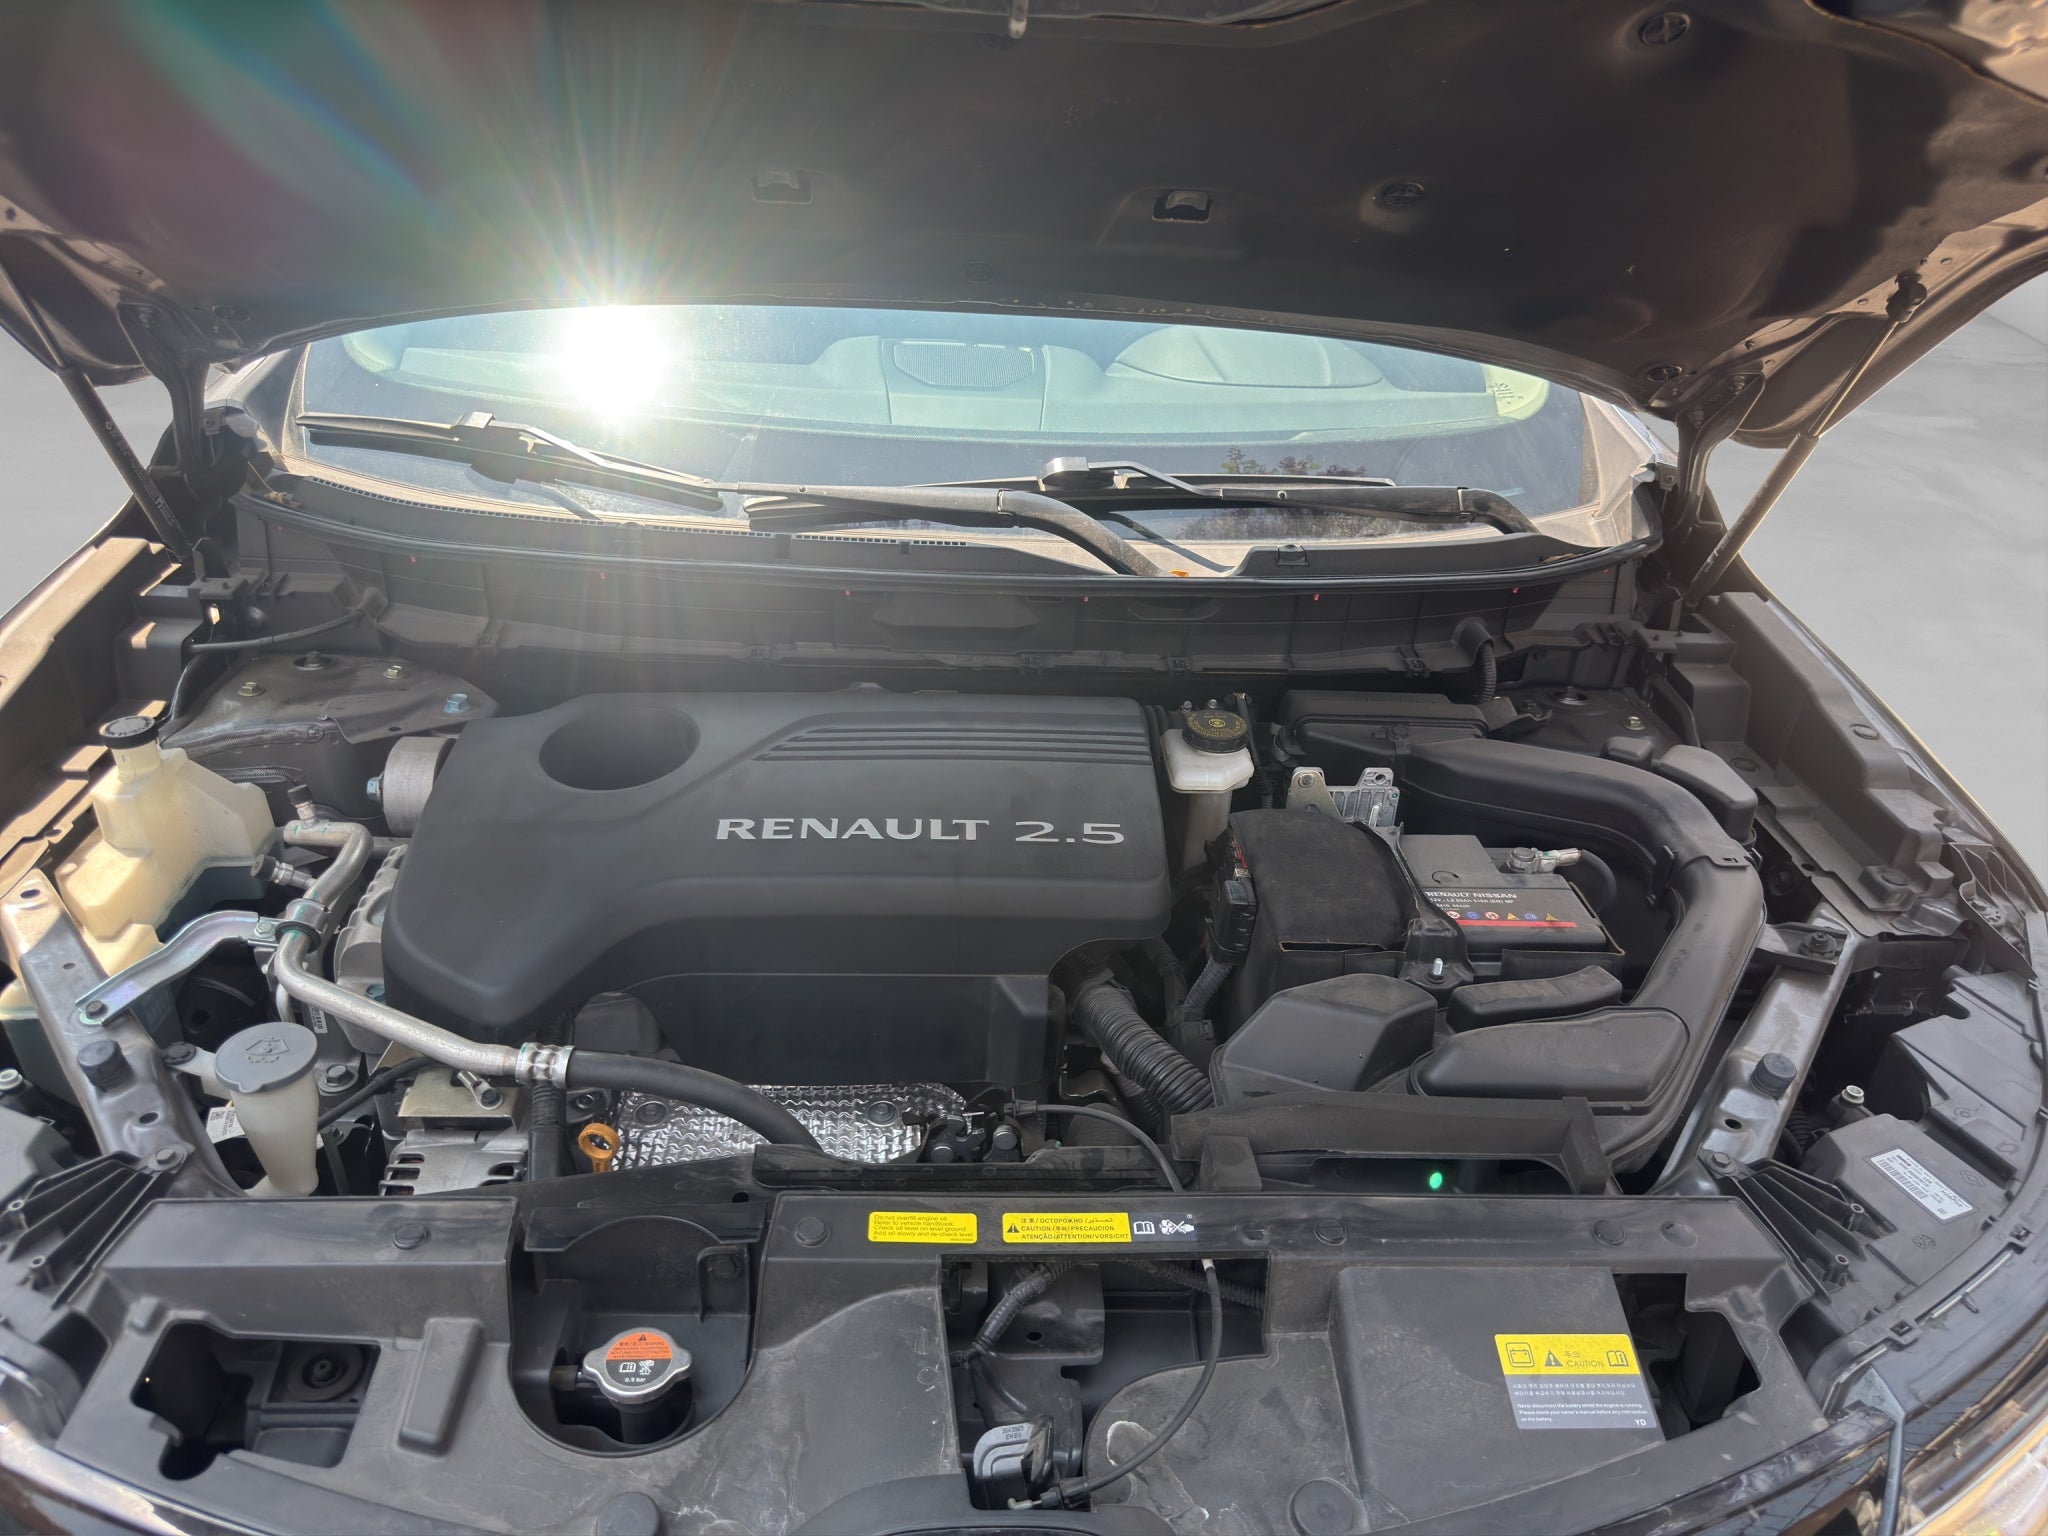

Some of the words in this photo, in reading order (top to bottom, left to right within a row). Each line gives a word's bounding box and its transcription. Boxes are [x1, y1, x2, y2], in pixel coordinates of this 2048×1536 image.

[716, 818, 989, 840] RENAULT
[1015, 821, 1125, 844] 2.5
[1567, 1360, 1604, 1368] CAUTION
[1635, 1418, 1646, 1426] YD
